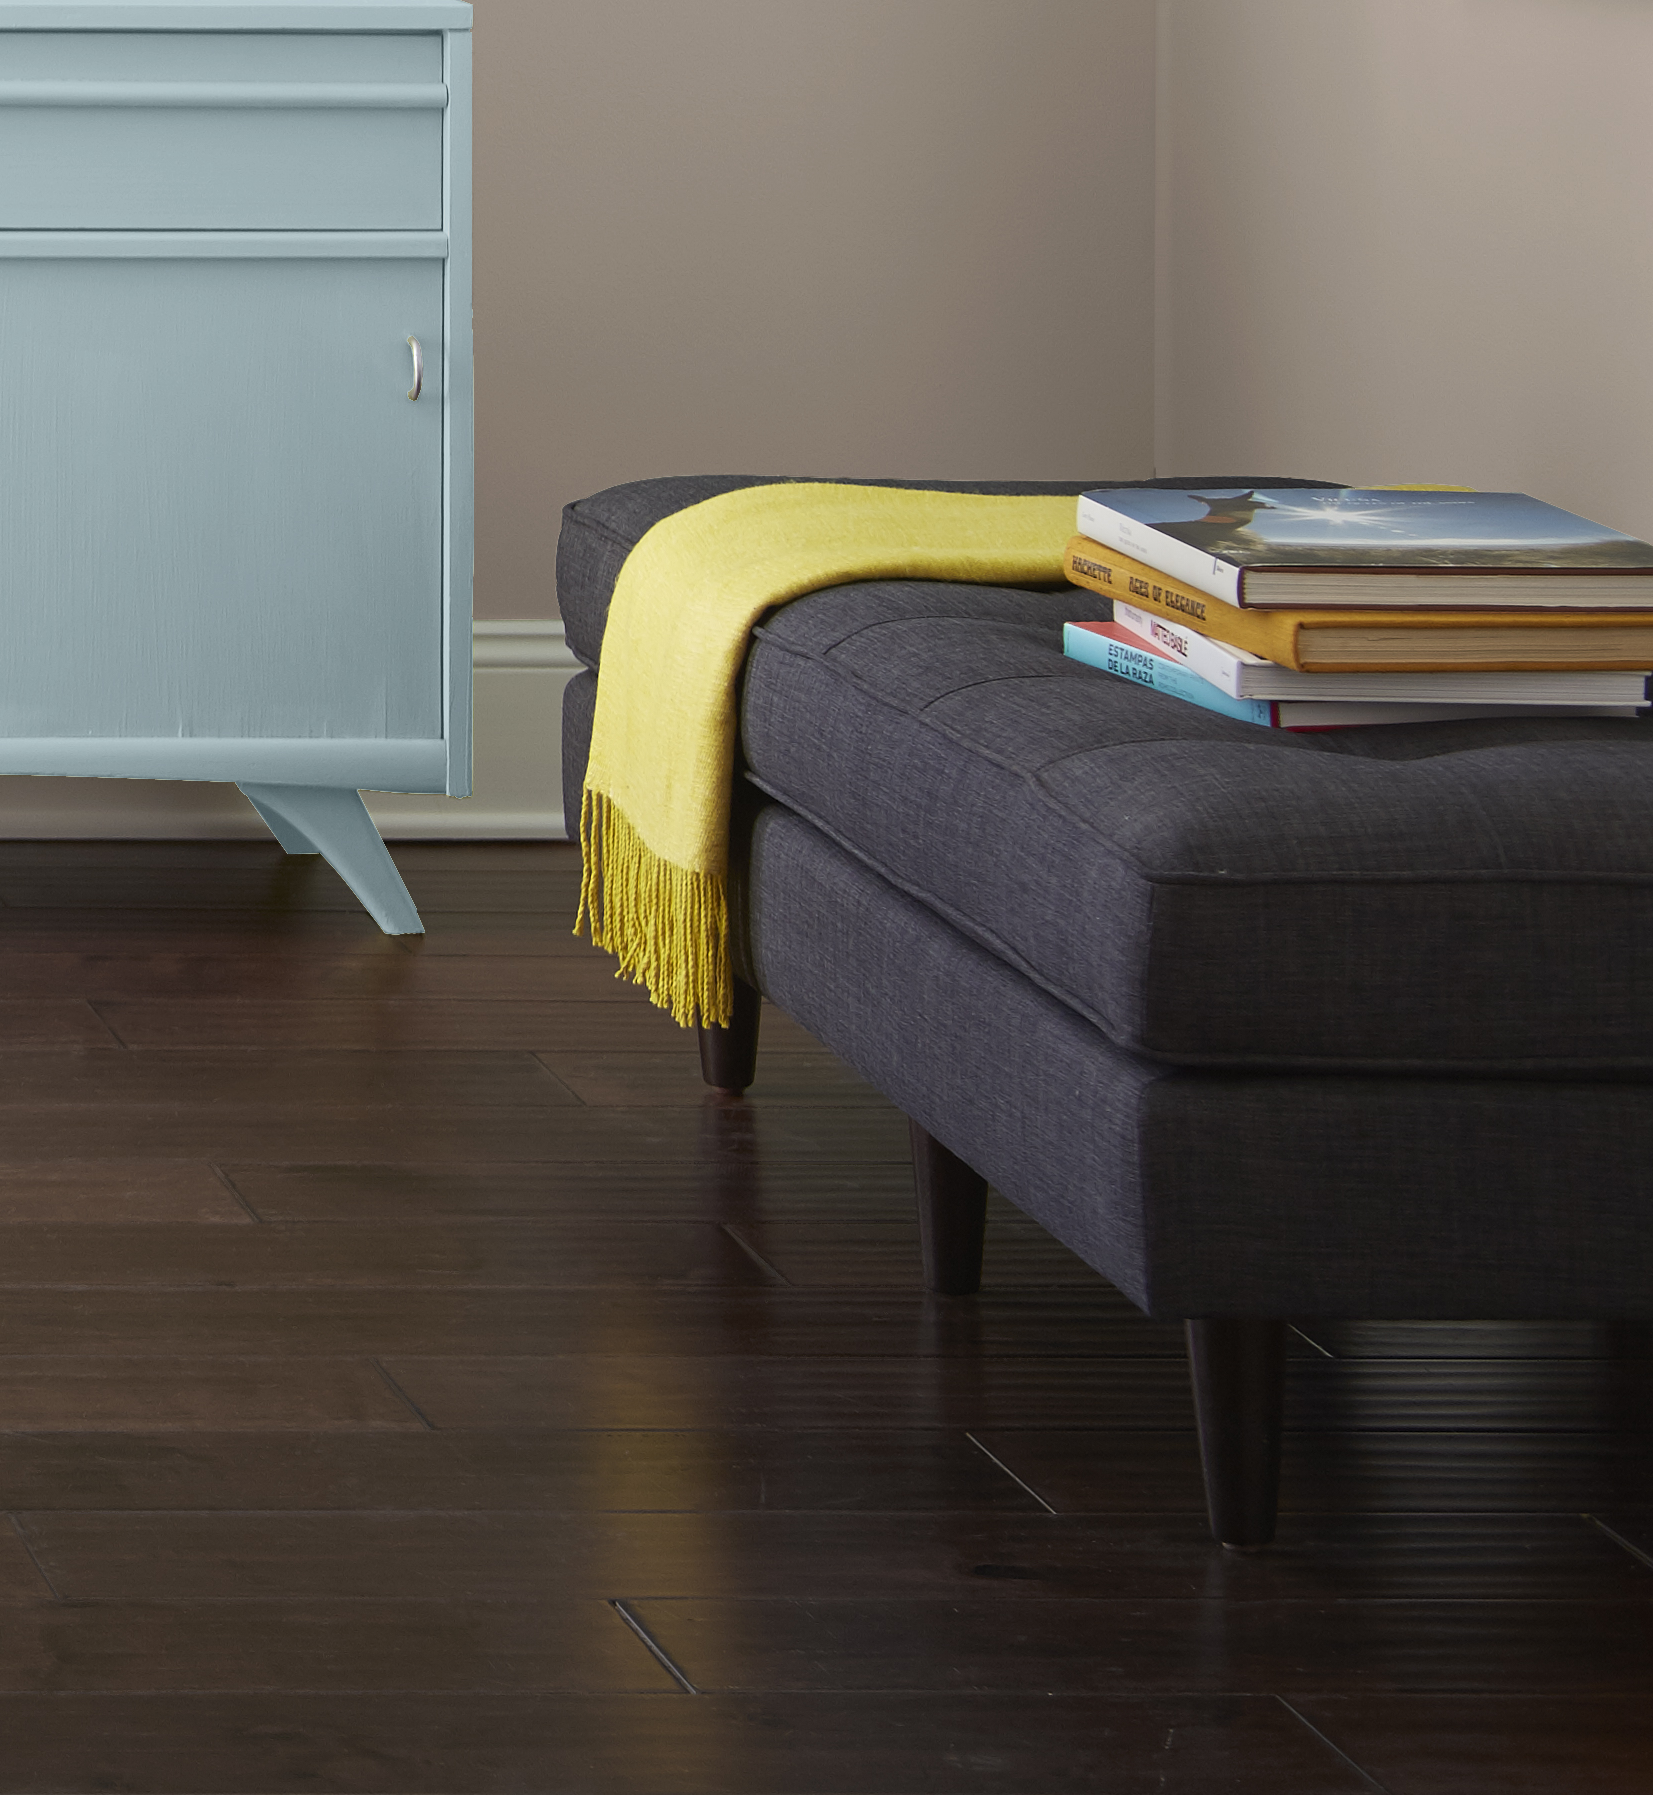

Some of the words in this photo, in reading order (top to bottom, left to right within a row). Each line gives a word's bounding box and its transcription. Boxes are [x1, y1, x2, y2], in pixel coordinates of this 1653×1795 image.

[1072, 555, 1112, 584] HACHETTE
[1129, 576, 1150, 599] AGES
[1152, 584, 1163, 603] OF
[1165, 590, 1206, 621] ELEGANCE
[1108, 643, 1155, 671] ESTAMPAS
[1107, 658, 1119, 673] DE
[1119, 663, 1131, 677] LA
[1132, 667, 1155, 686] RAZA
